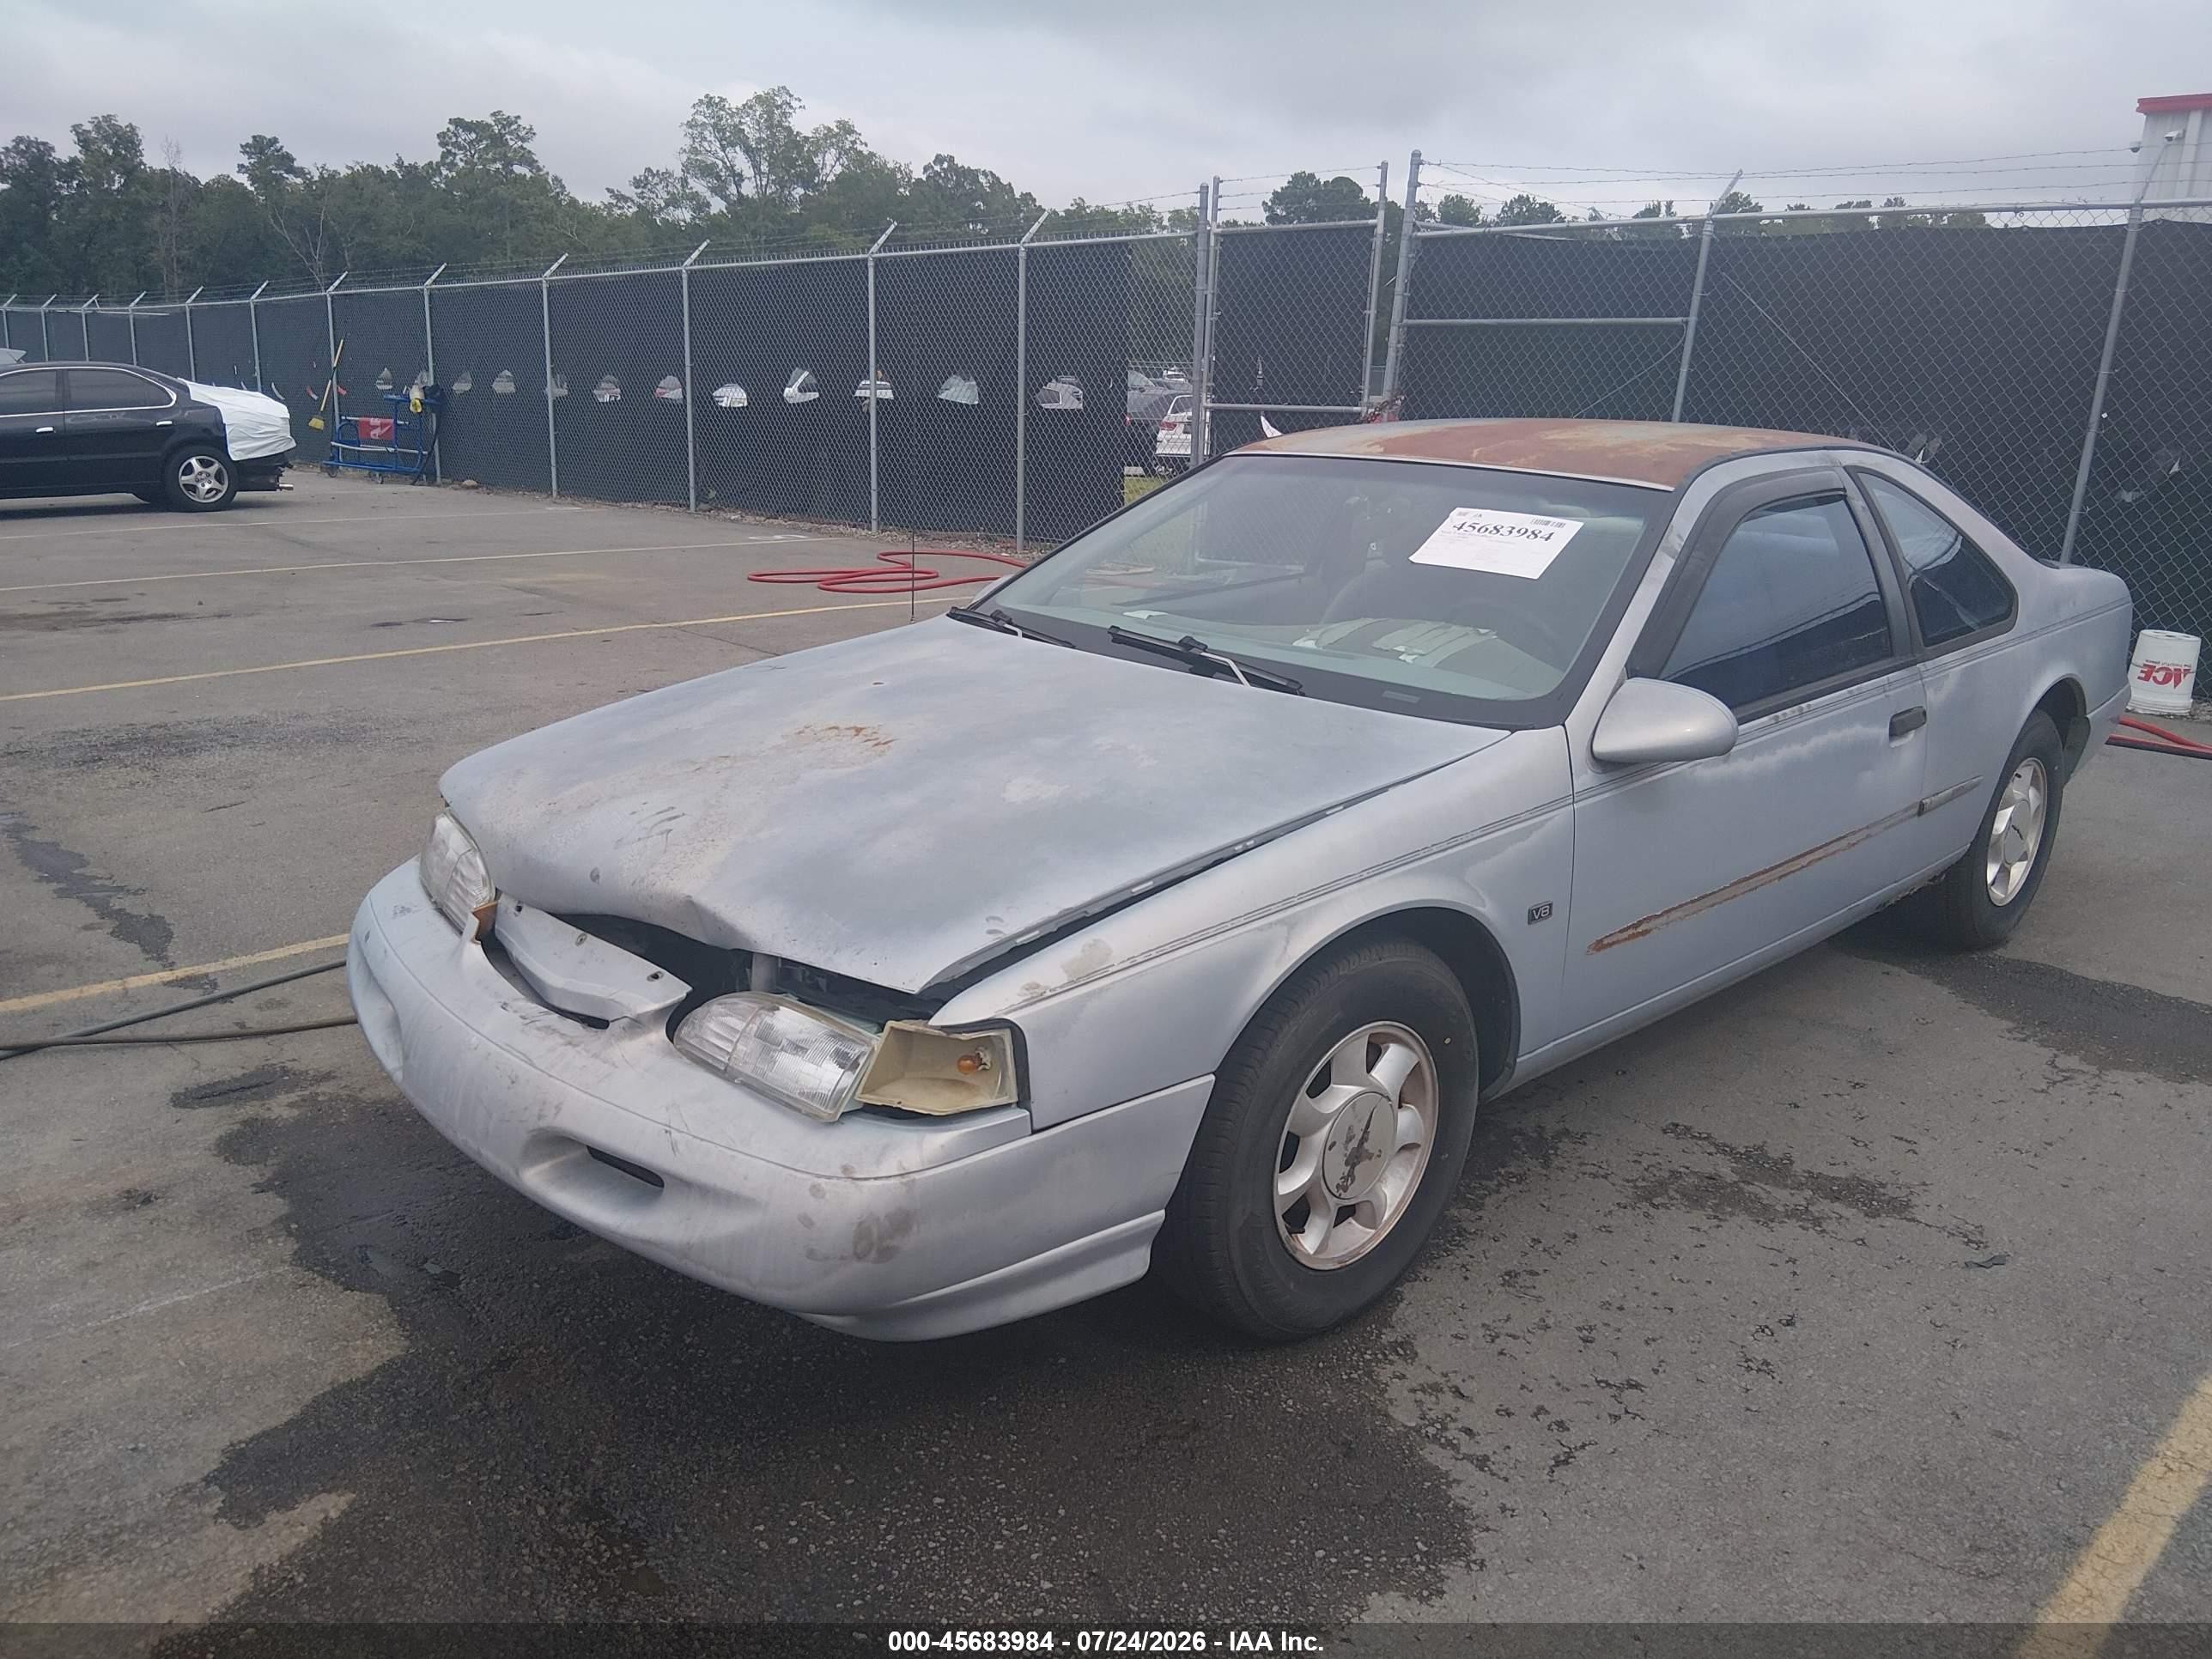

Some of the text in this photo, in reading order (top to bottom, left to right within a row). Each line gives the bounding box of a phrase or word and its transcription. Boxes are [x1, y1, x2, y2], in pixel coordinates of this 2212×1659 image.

[1453, 520, 1554, 542] 45683984
[2136, 664, 2191, 689] ACE
[1532, 905, 1550, 920] V8
